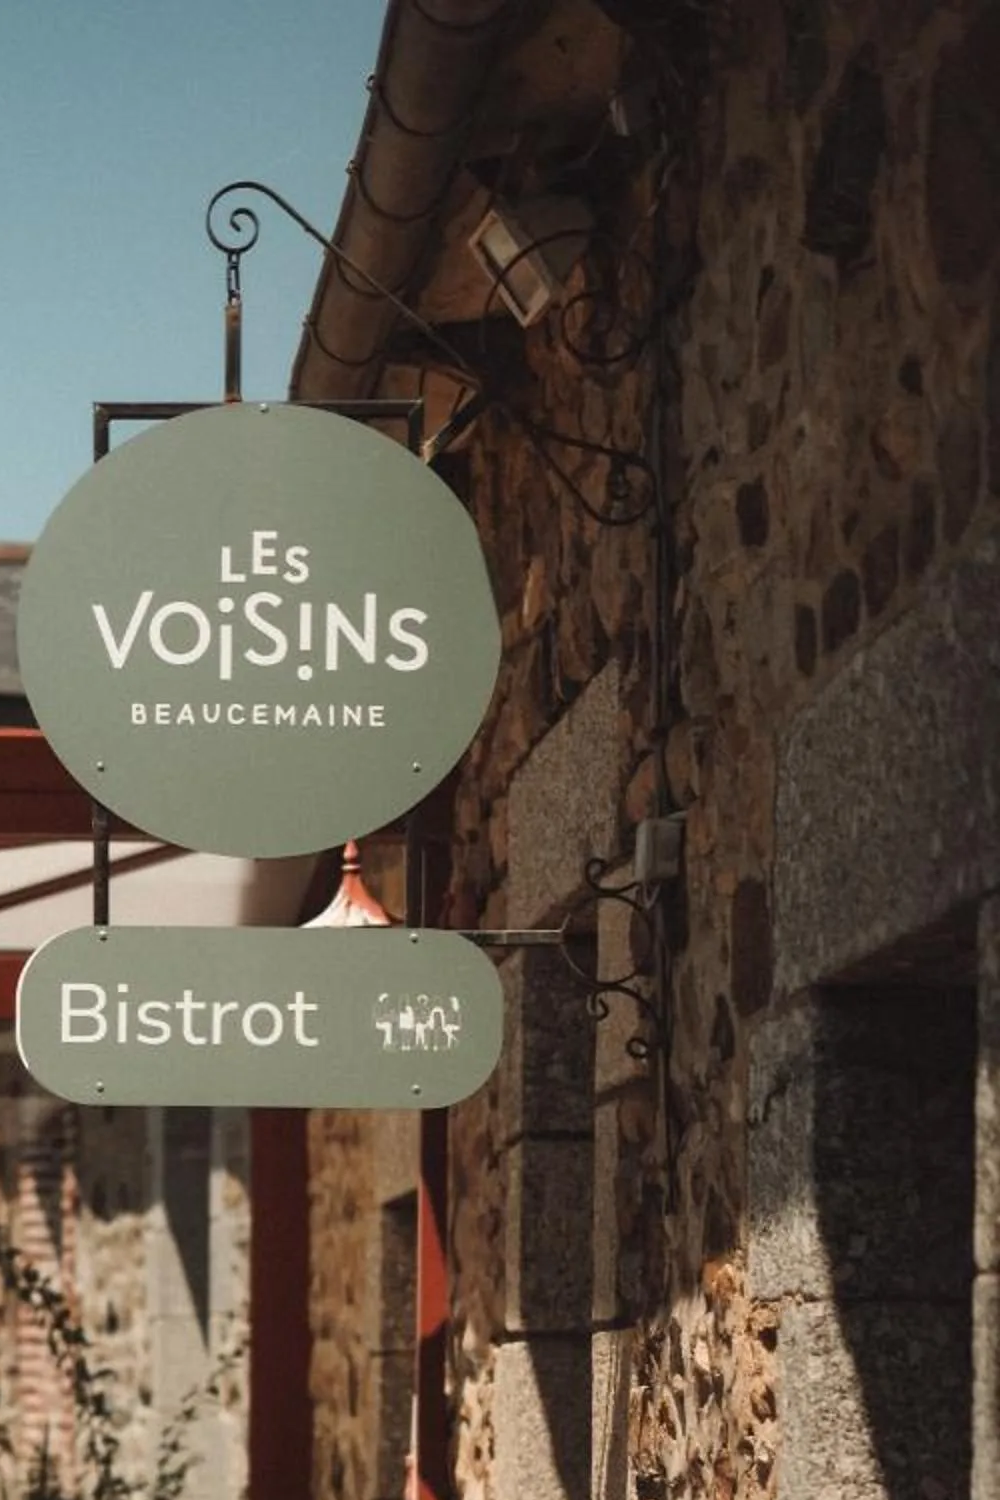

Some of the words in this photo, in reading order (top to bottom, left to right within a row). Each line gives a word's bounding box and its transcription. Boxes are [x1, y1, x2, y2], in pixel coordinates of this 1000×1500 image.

[221, 530, 309, 584] LES
[131, 703, 385, 727] BEAUCEMAINE
[60, 982, 319, 1047] Bistrot
